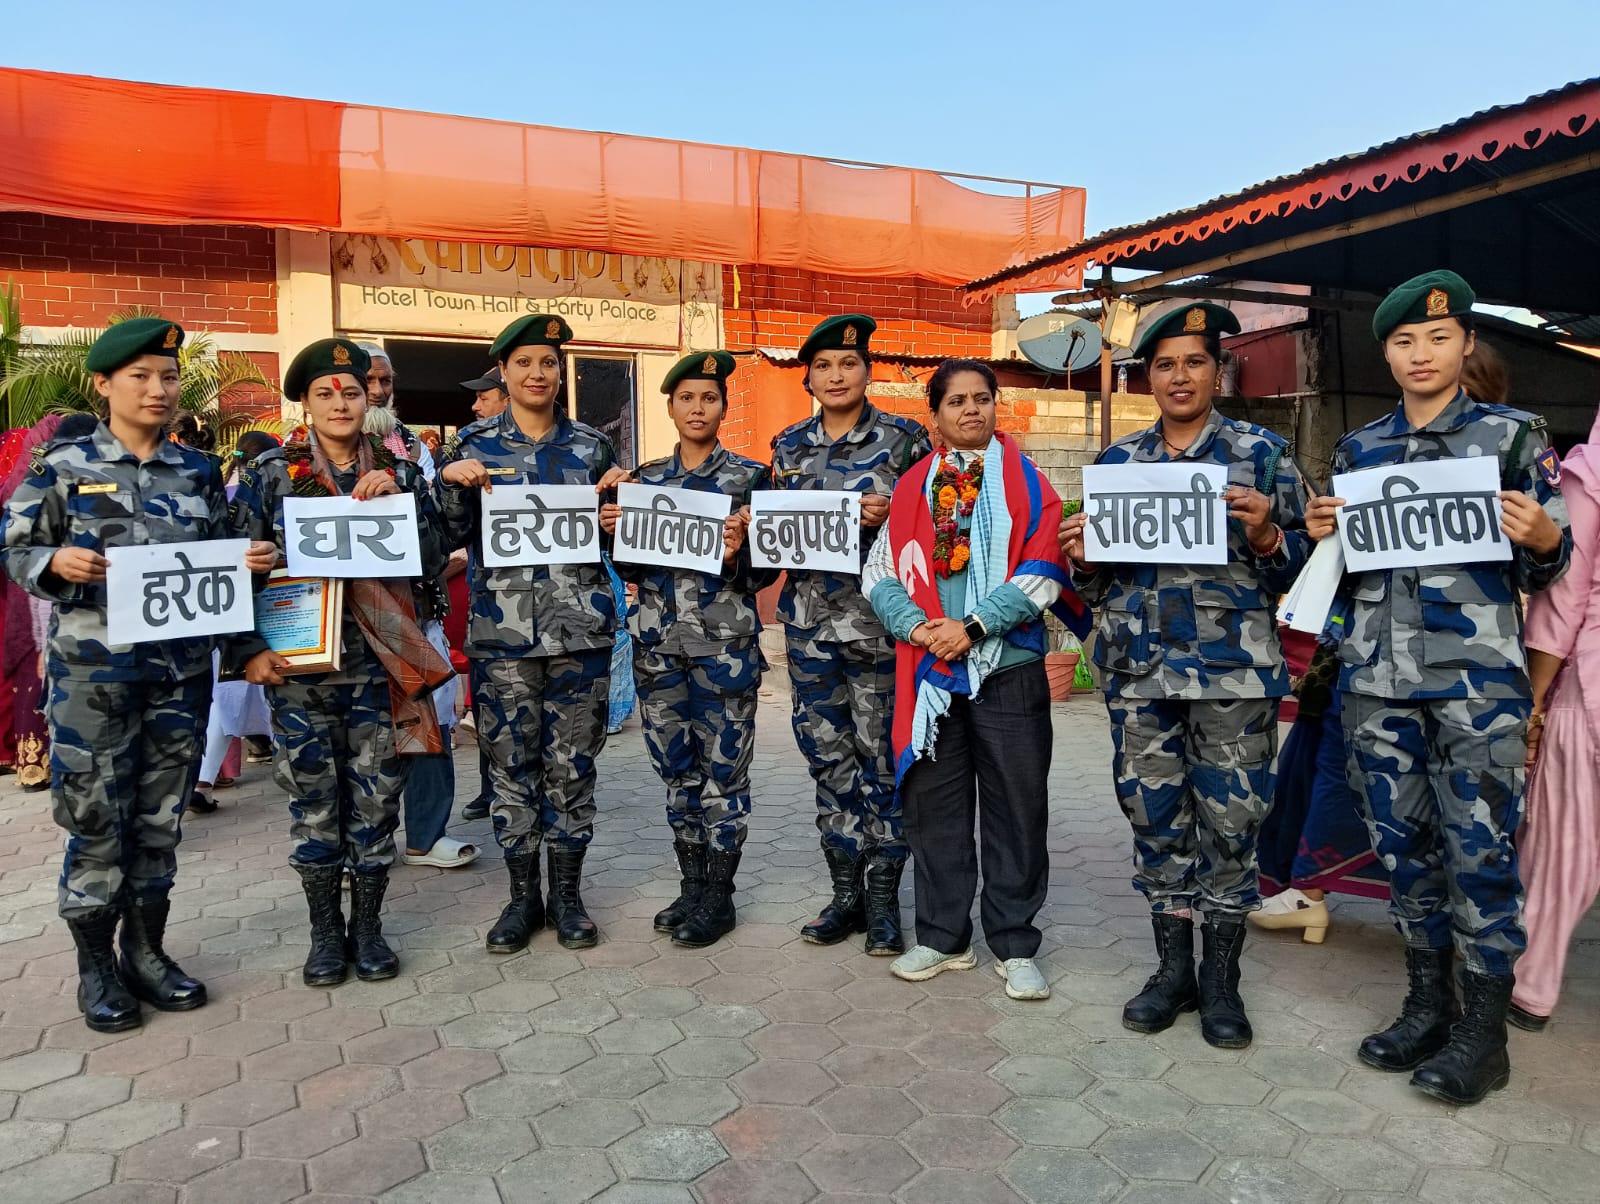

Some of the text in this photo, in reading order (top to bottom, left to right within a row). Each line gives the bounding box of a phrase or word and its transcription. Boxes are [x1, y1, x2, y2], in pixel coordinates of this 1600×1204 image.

[362, 285, 657, 321] Hotel Town Hall & Party Palace
[295, 514, 408, 561] घर
[489, 493, 596, 557] हरेक
[620, 493, 726, 560] पालिका
[1089, 472, 1217, 550] साहासी
[1342, 475, 1501, 552] बालिका
[142, 551, 238, 627] हरेक
